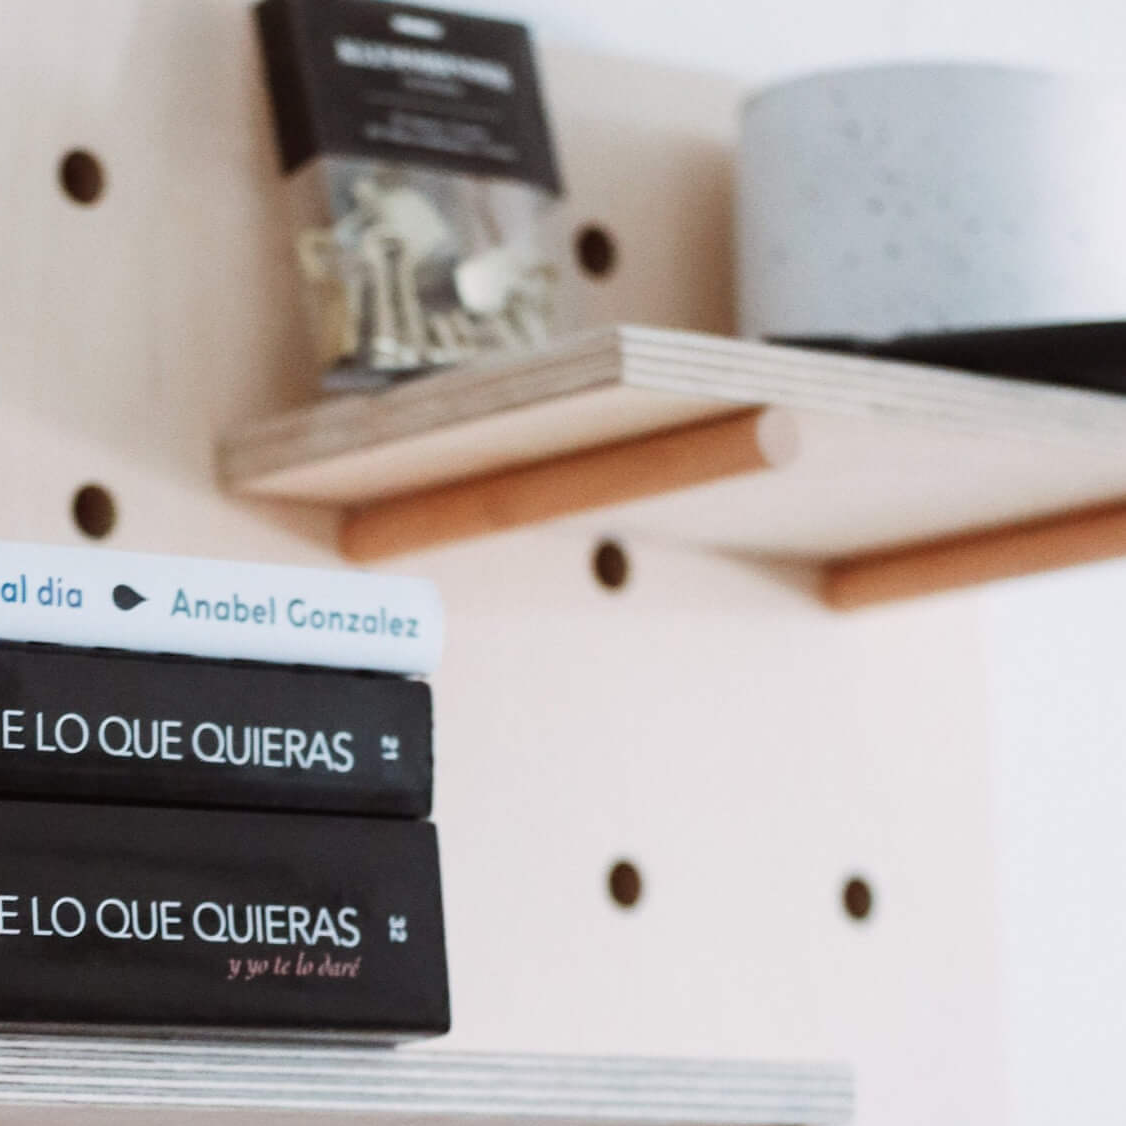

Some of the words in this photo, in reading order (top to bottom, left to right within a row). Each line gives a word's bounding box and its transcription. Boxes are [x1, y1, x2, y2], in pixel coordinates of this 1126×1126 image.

[171, 588, 275, 624] Anabel
[287, 598, 418, 638] Gonzalez
[37, 712, 89, 753] LO
[98, 716, 183, 760] QUE
[192, 723, 354, 772] QUIERAS
[32, 896, 86, 937] LO
[96, 899, 184, 940] QUE
[193, 902, 360, 947] QUIERAS
[228, 959, 241, 979] y
[246, 960, 268, 980] yo
[274, 957, 290, 974] te
[296, 952, 314, 975] lo
[318, 954, 361, 977] daré
